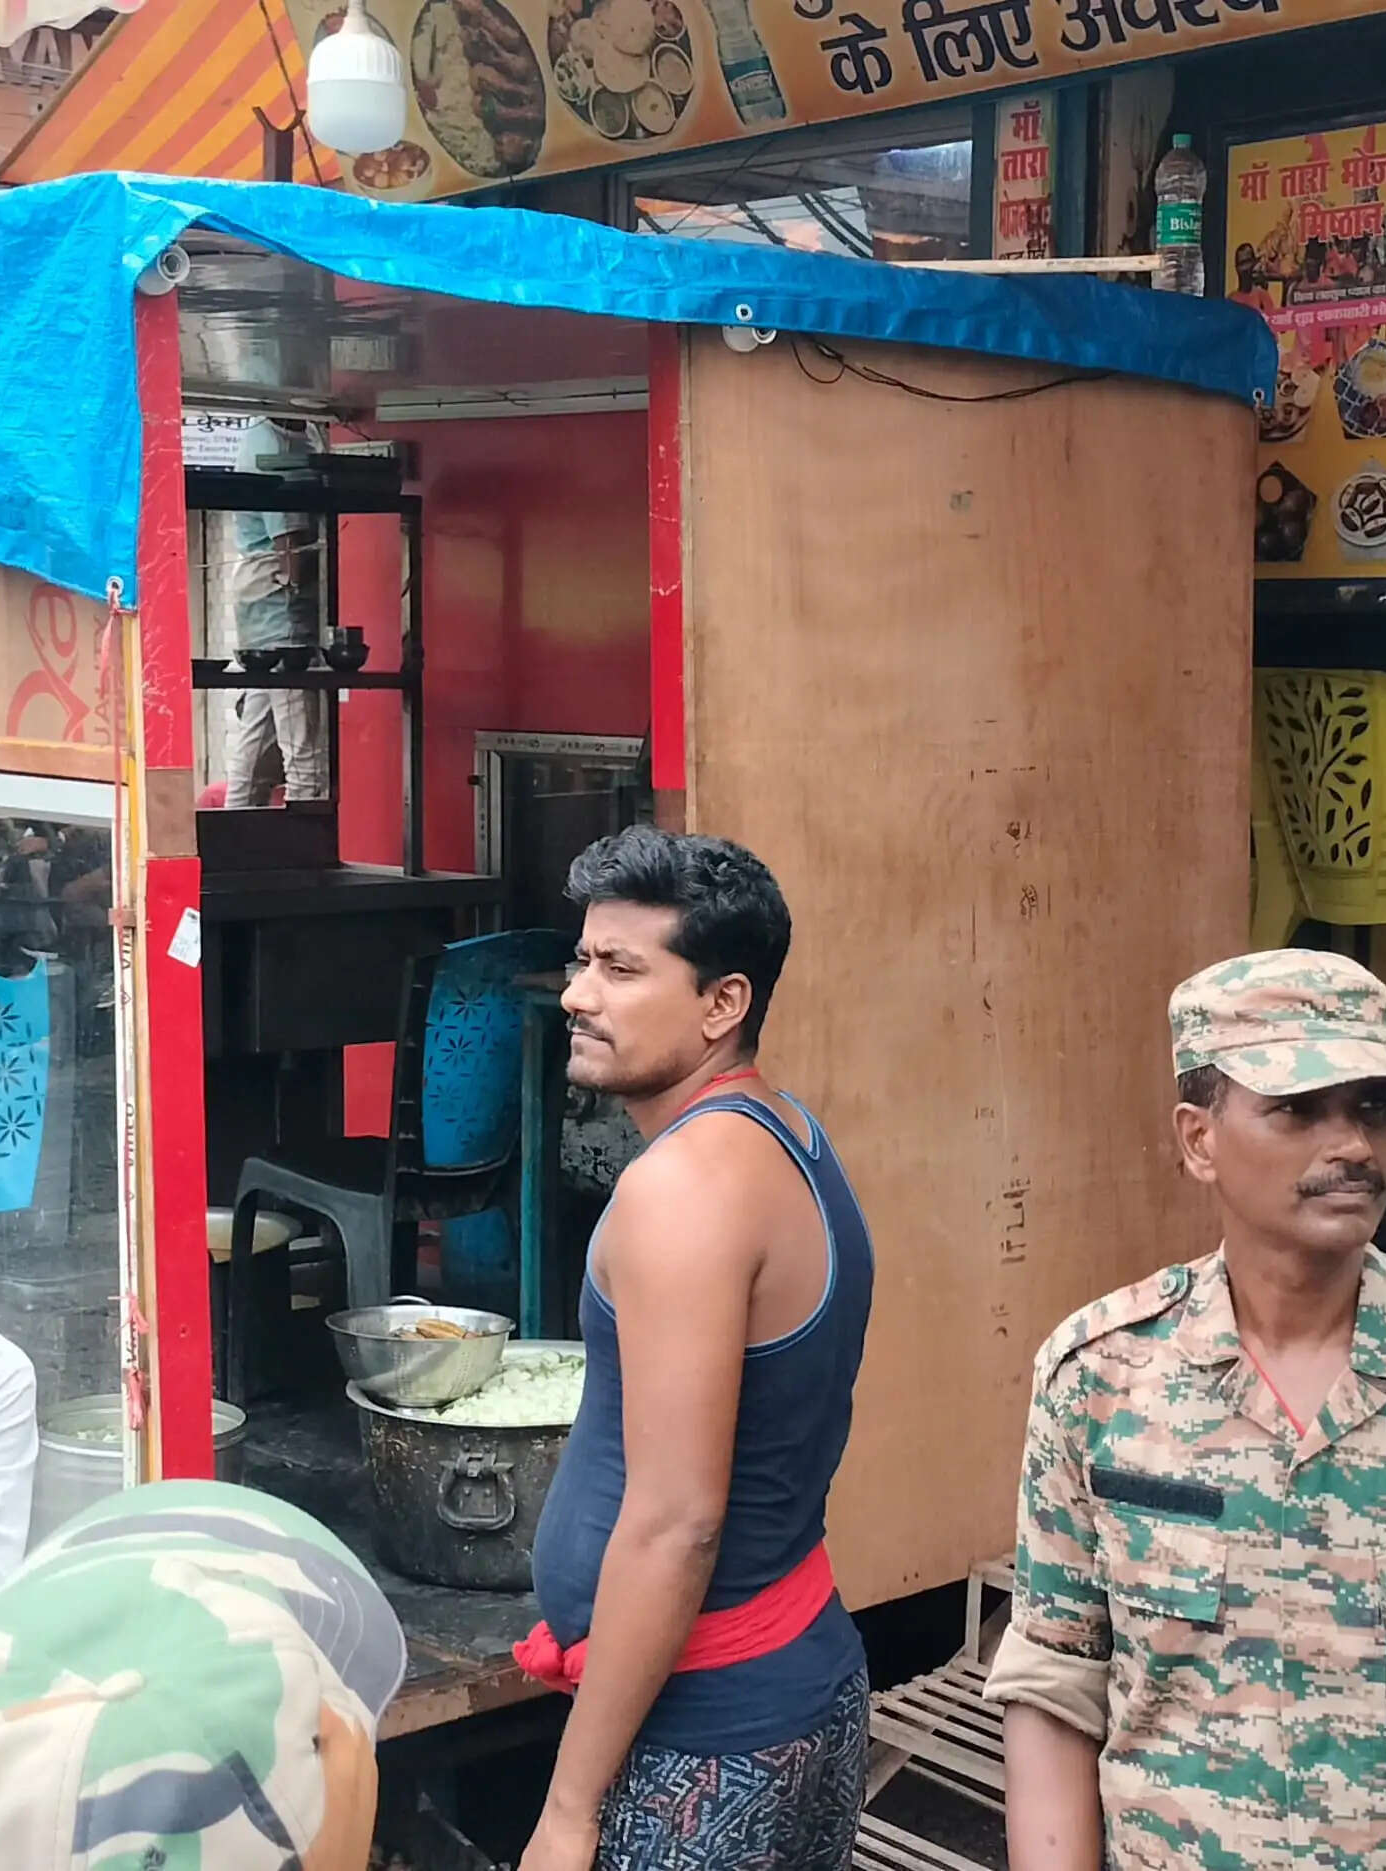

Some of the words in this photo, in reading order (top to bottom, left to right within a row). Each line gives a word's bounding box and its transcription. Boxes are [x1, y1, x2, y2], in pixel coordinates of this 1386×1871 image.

[819, 13, 888, 94] के
[902, 0, 1040, 82] लिए
[1001, 147, 1049, 182] तारा
[1279, 161, 1331, 197] तारा
